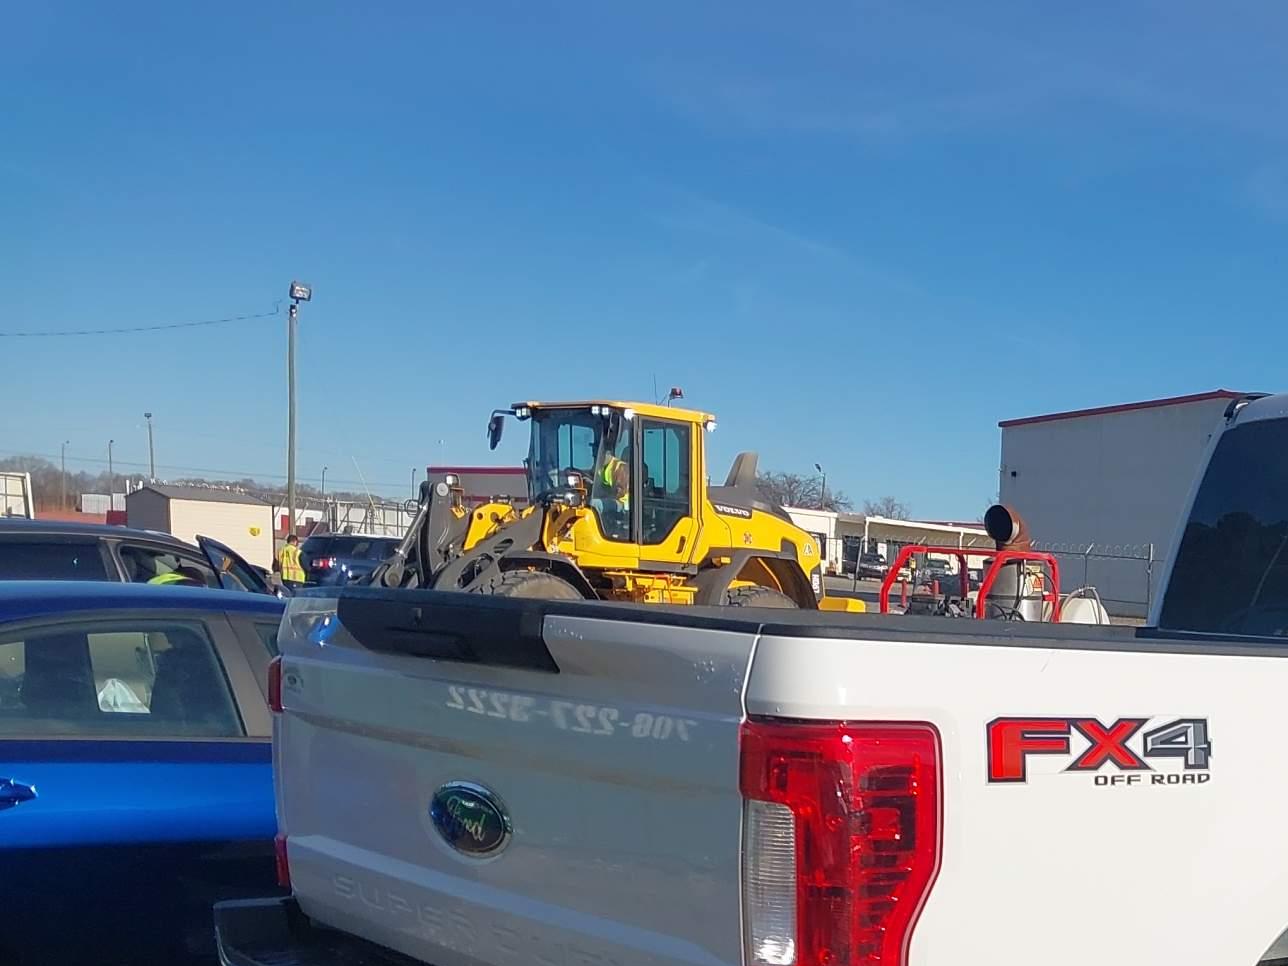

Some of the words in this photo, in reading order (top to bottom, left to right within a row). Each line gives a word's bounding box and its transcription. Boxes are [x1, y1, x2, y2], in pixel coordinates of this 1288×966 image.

[714, 505, 750, 517] VOLVO
[986, 717, 1212, 783] FX4
[1094, 774, 1141, 786] OFF
[1151, 773, 1211, 786] ROAD
